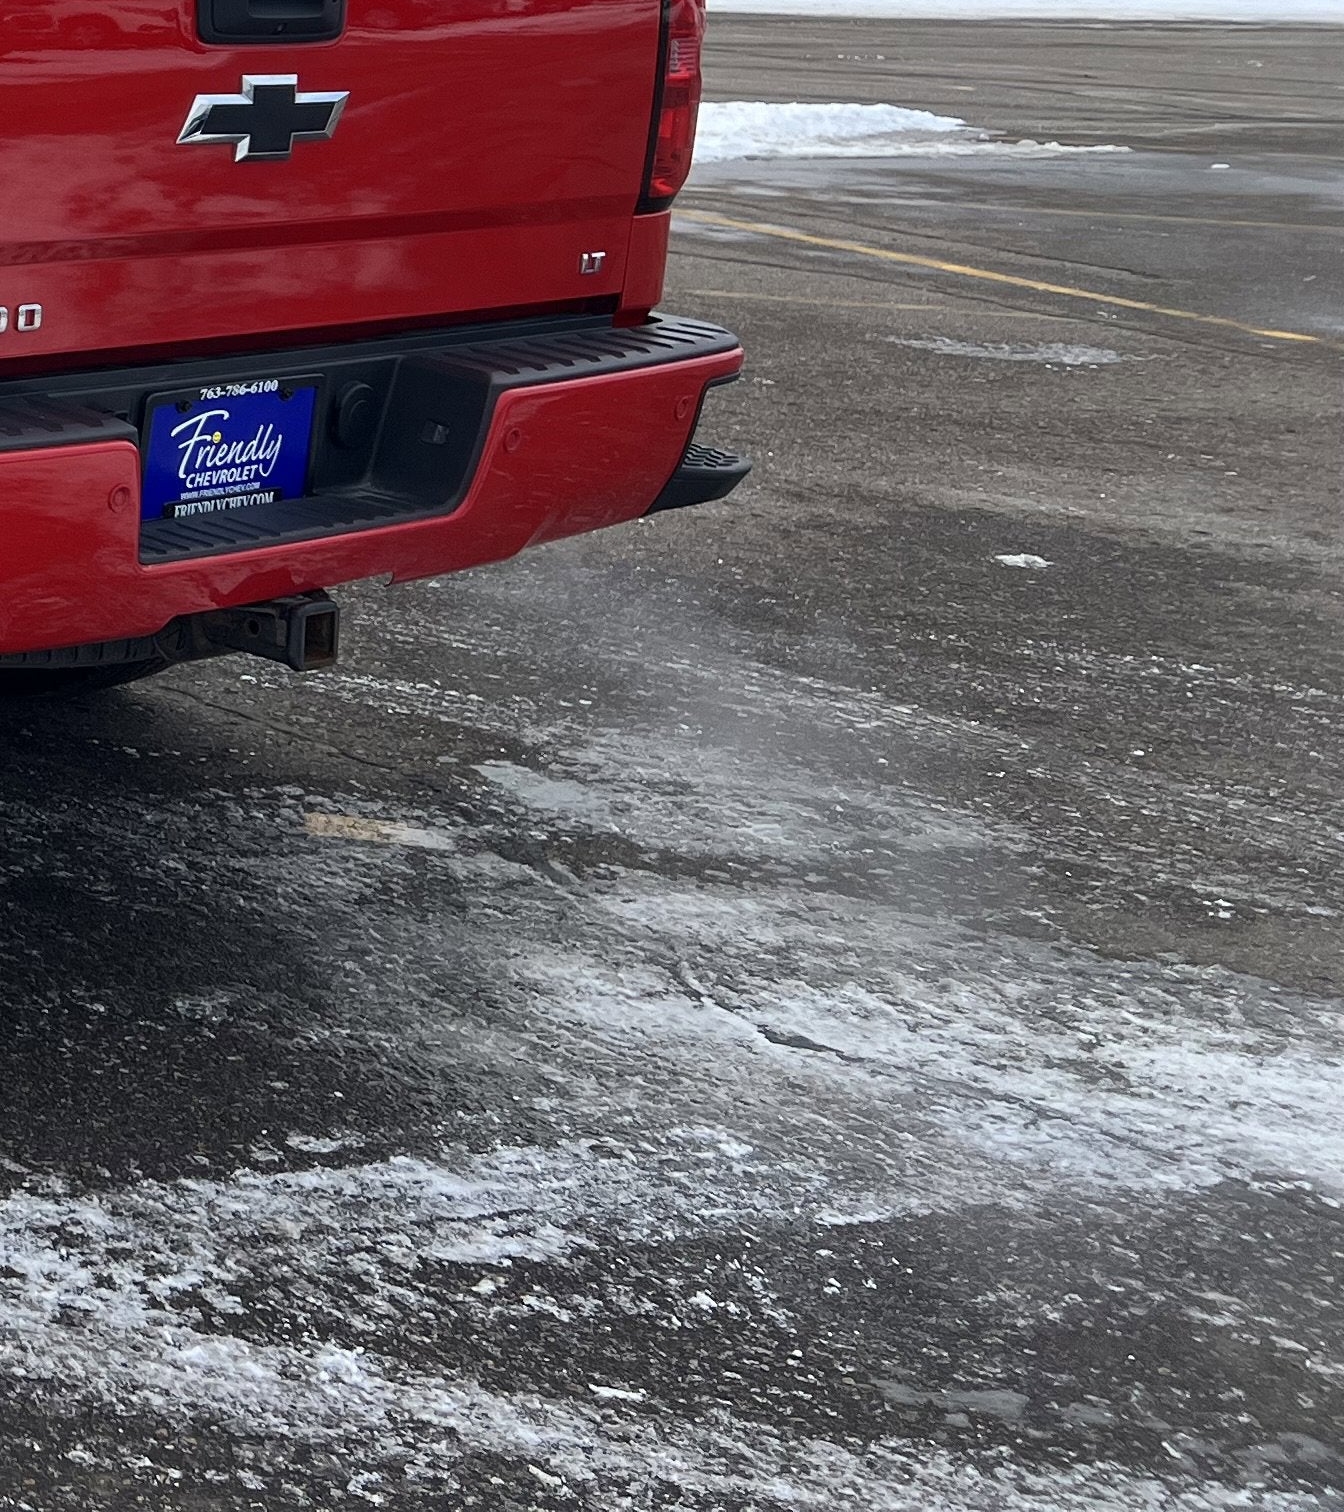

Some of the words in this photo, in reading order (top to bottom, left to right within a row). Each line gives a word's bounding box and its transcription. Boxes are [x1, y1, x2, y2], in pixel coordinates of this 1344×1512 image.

[580, 251, 606, 275] LT
[199, 379, 279, 400] 763-786-6100
[170, 409, 283, 479] Friendly
[185, 464, 259, 489] CHEVROLET
[173, 491, 275, 518] FRIENDLYCHEVCOM
